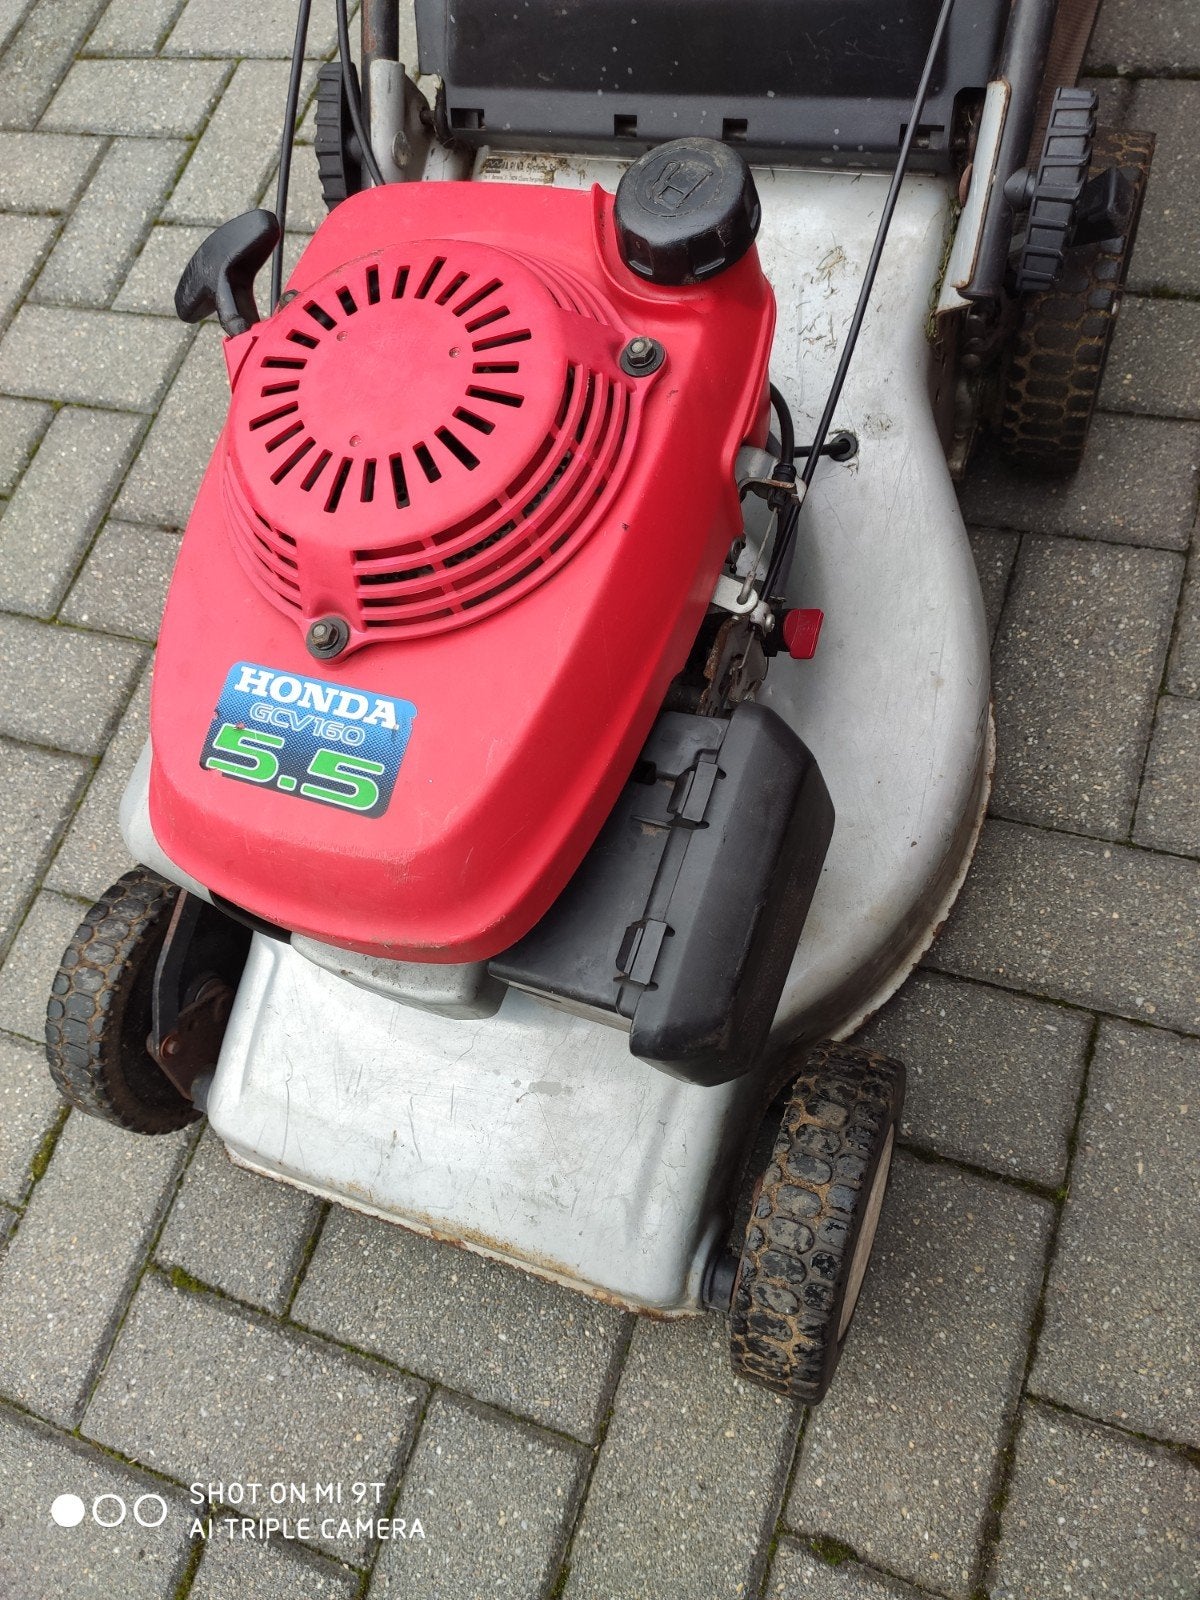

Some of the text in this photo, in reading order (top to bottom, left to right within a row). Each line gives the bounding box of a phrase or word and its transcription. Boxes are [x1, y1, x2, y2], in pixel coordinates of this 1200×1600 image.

[234, 666, 399, 730] HONDA
[250, 702, 365, 747] GCV160
[206, 723, 385, 811] 5.5
